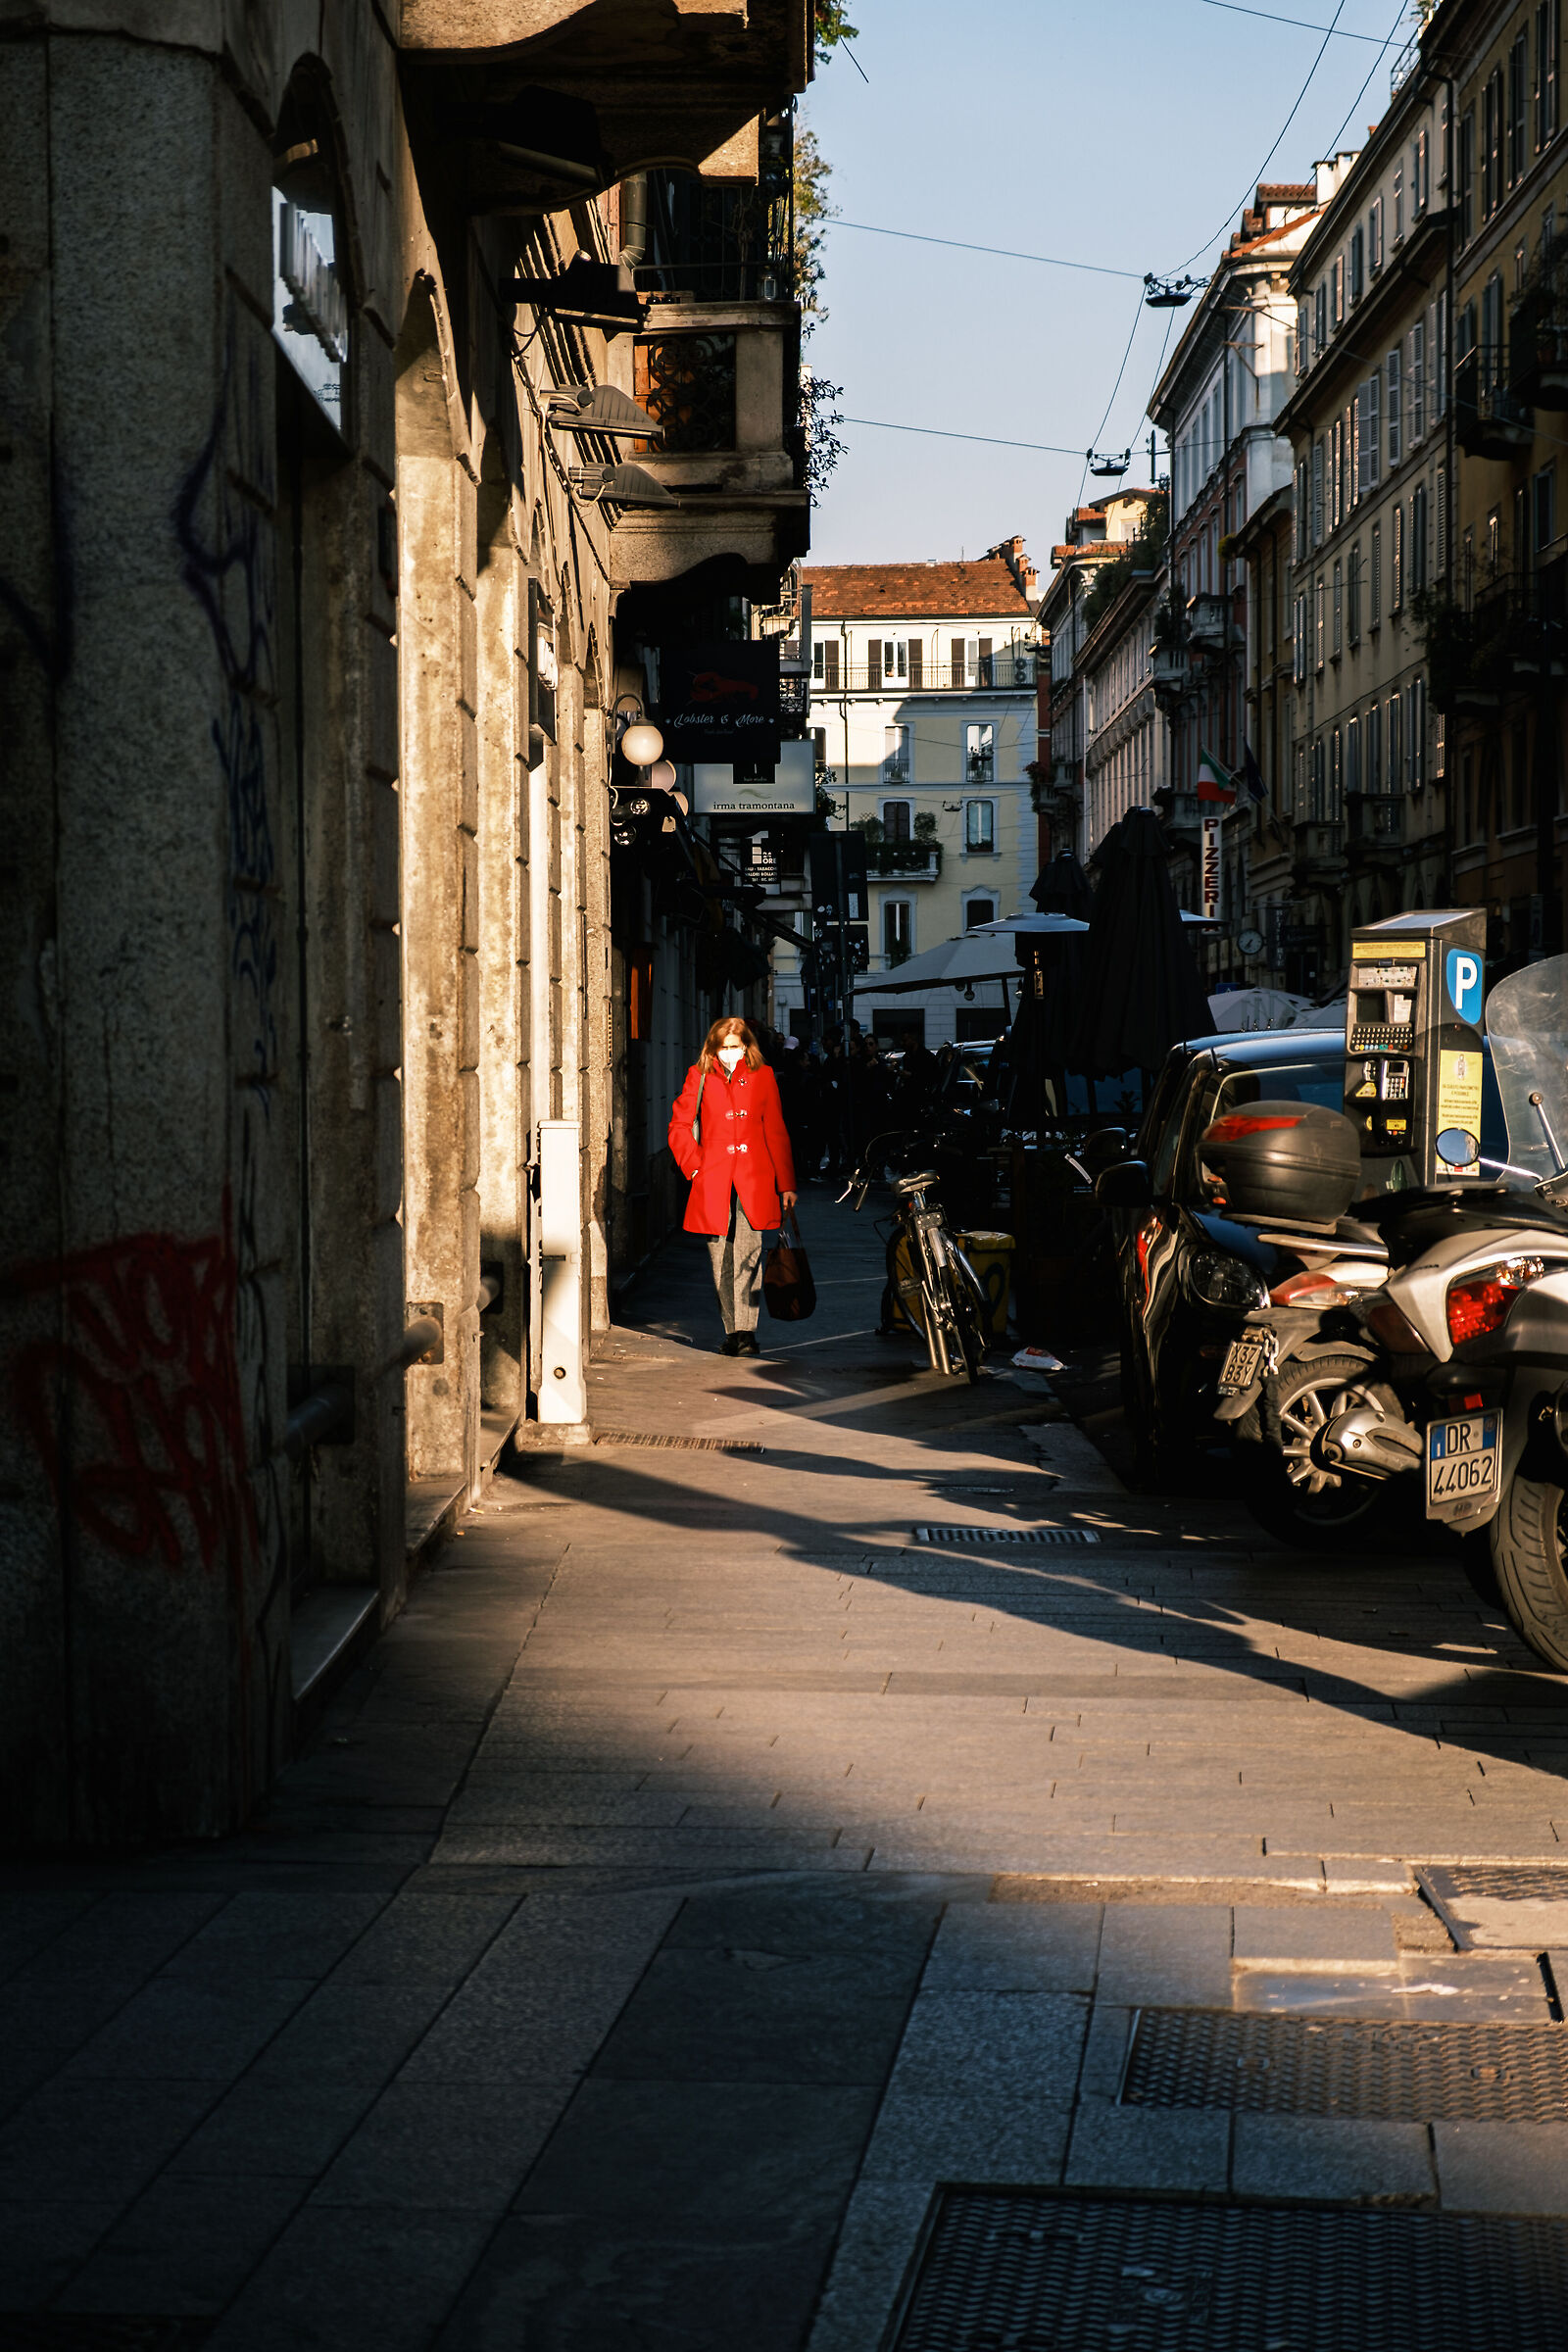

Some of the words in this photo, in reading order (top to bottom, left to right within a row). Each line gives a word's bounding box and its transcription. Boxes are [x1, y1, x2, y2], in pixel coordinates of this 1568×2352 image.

[673, 713, 714, 728] Lobster
[735, 713, 764, 727] More
[1204, 818, 1219, 932] PIZZERI
[1455, 956, 1478, 1009] P
[1232, 1344, 1258, 1365] X3Z
[1226, 1364, 1252, 1384] B3Y
[1447, 1423, 1471, 1454] DR
[1434, 1455, 1493, 1495] 44062
